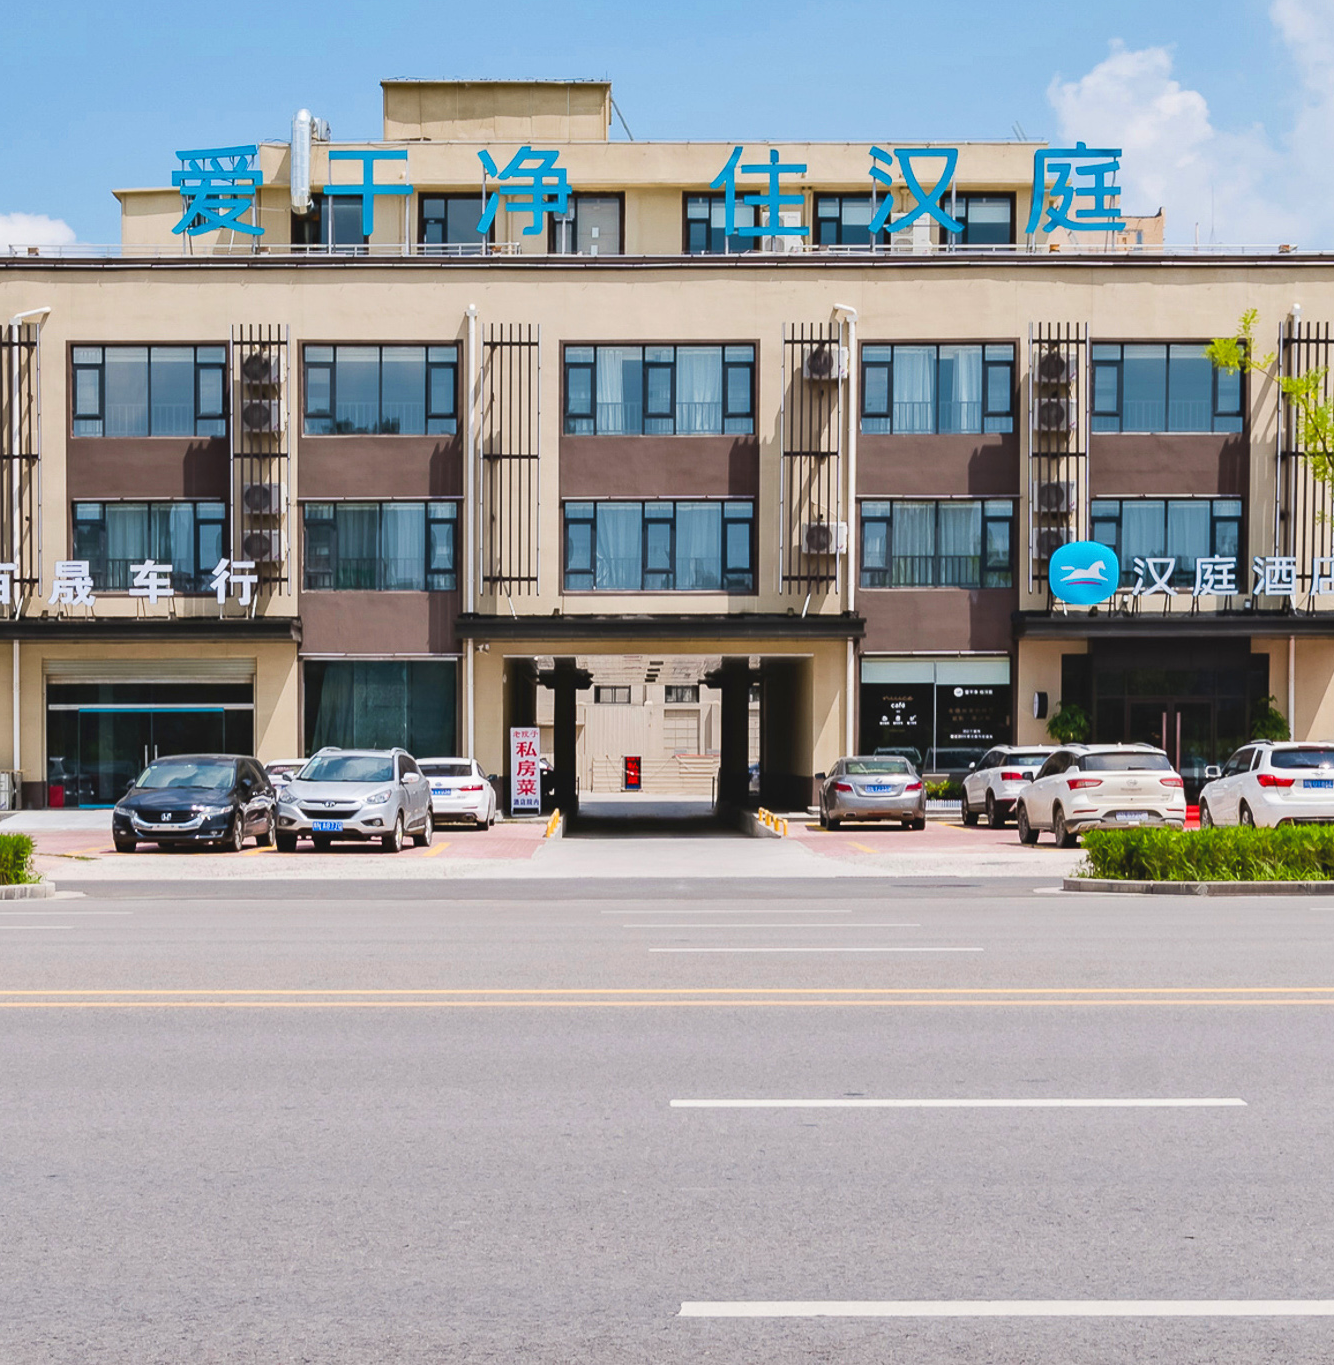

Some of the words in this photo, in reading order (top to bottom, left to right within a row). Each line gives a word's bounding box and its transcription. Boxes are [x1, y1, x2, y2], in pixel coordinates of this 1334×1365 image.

[171, 144, 572, 236] 爱干净
[709, 141, 1126, 236] 住汉庭
[516, 741, 537, 796] 私房菜
